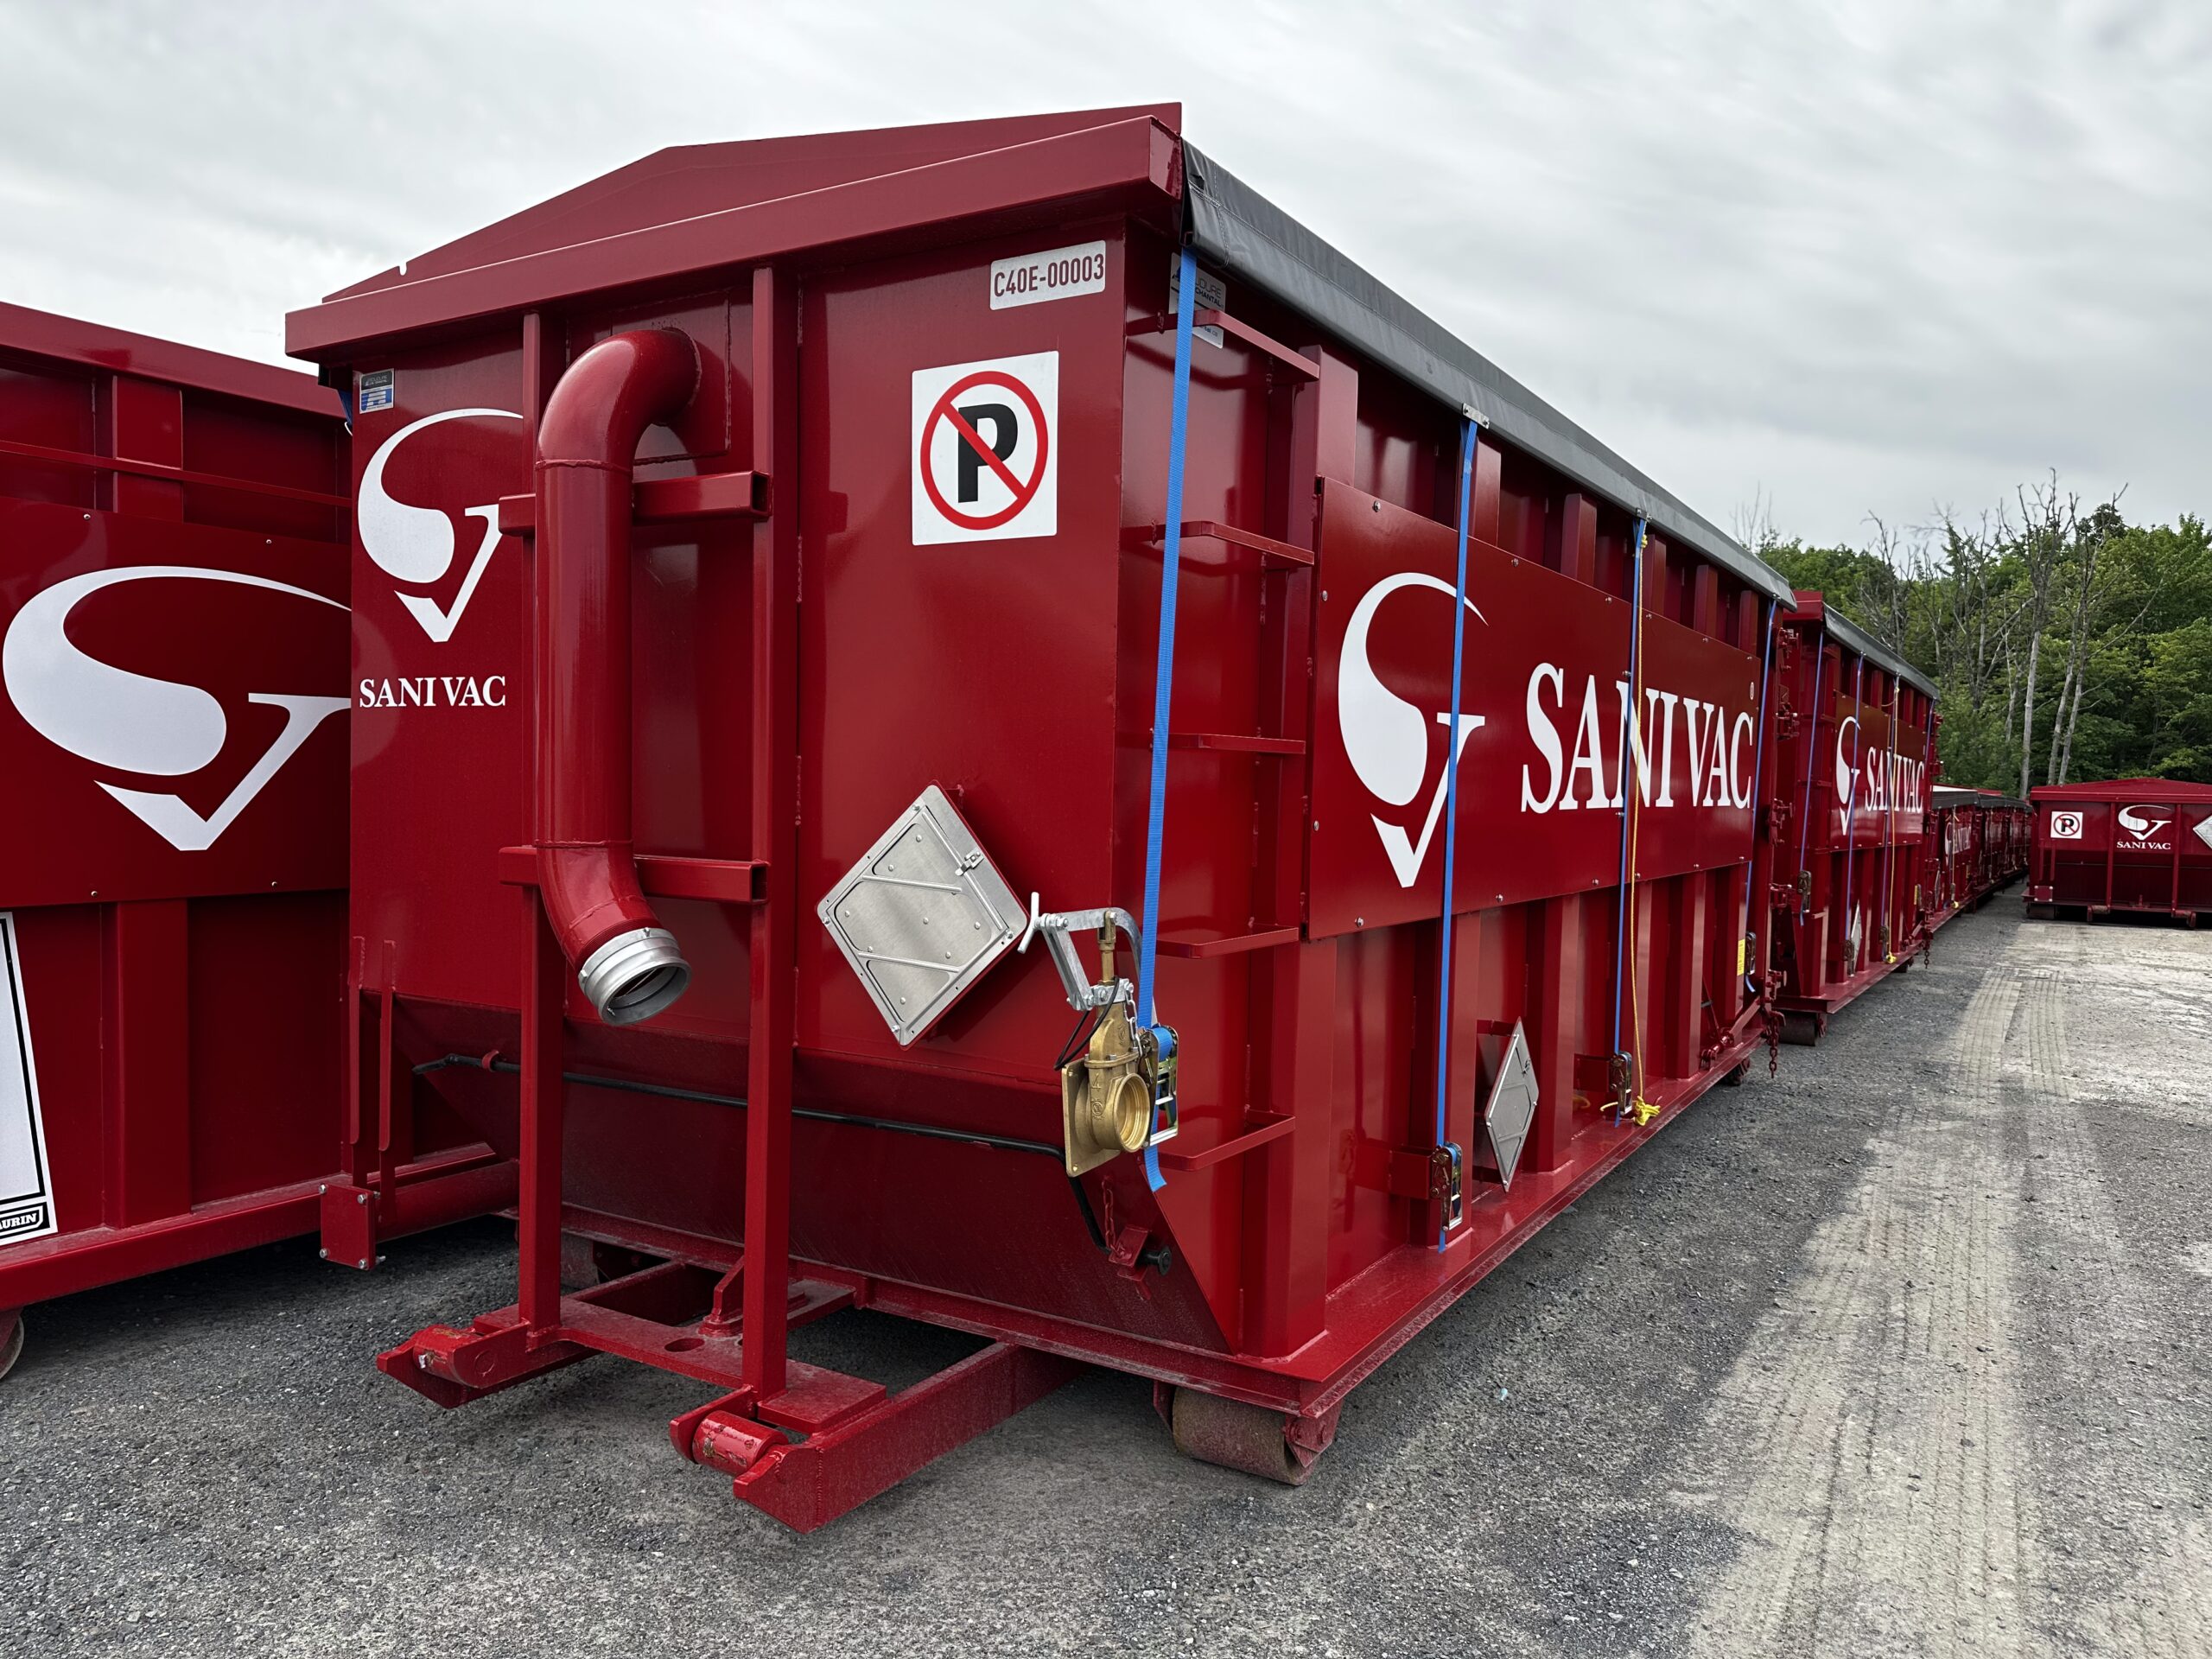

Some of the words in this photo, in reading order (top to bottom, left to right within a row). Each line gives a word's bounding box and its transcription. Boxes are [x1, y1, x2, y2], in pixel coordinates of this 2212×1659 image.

[994, 253, 1104, 296] C40E-00003
[359, 677, 437, 709] SANI
[440, 675, 506, 707] VAC
[1521, 662, 1678, 814] SANI
[1682, 697, 1754, 810] VAC
[1865, 746, 1902, 812] SANI
[1903, 756, 1925, 814] VAC
[2116, 841, 2146, 849] SANI
[2147, 842, 2171, 850] VAC
